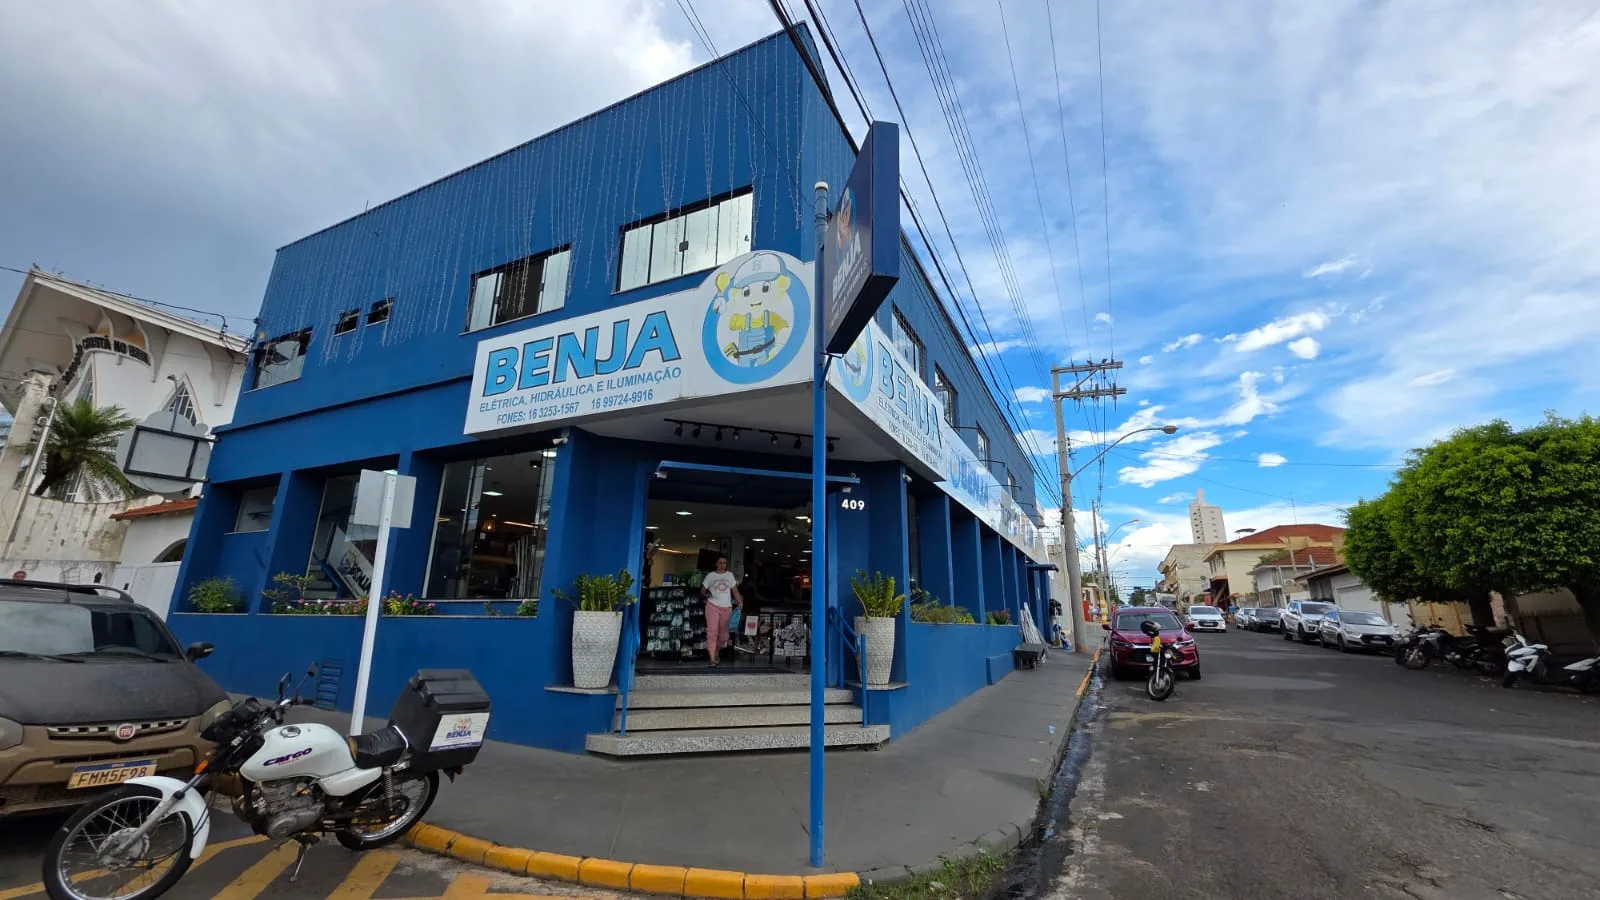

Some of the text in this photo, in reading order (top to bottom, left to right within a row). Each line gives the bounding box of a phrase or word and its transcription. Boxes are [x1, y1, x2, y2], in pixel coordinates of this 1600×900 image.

[482, 310, 682, 397] BENJA
[480, 366, 682, 412] ELÉTRICA, HIDRÁULICA E ILUMINAÇÃO
[496, 388, 654, 425] FONES: 16 3253-1567 16 99724-9916
[878, 340, 943, 451] BENJA
[841, 498, 865, 511] 409
[446, 730, 472, 739] BENJA
